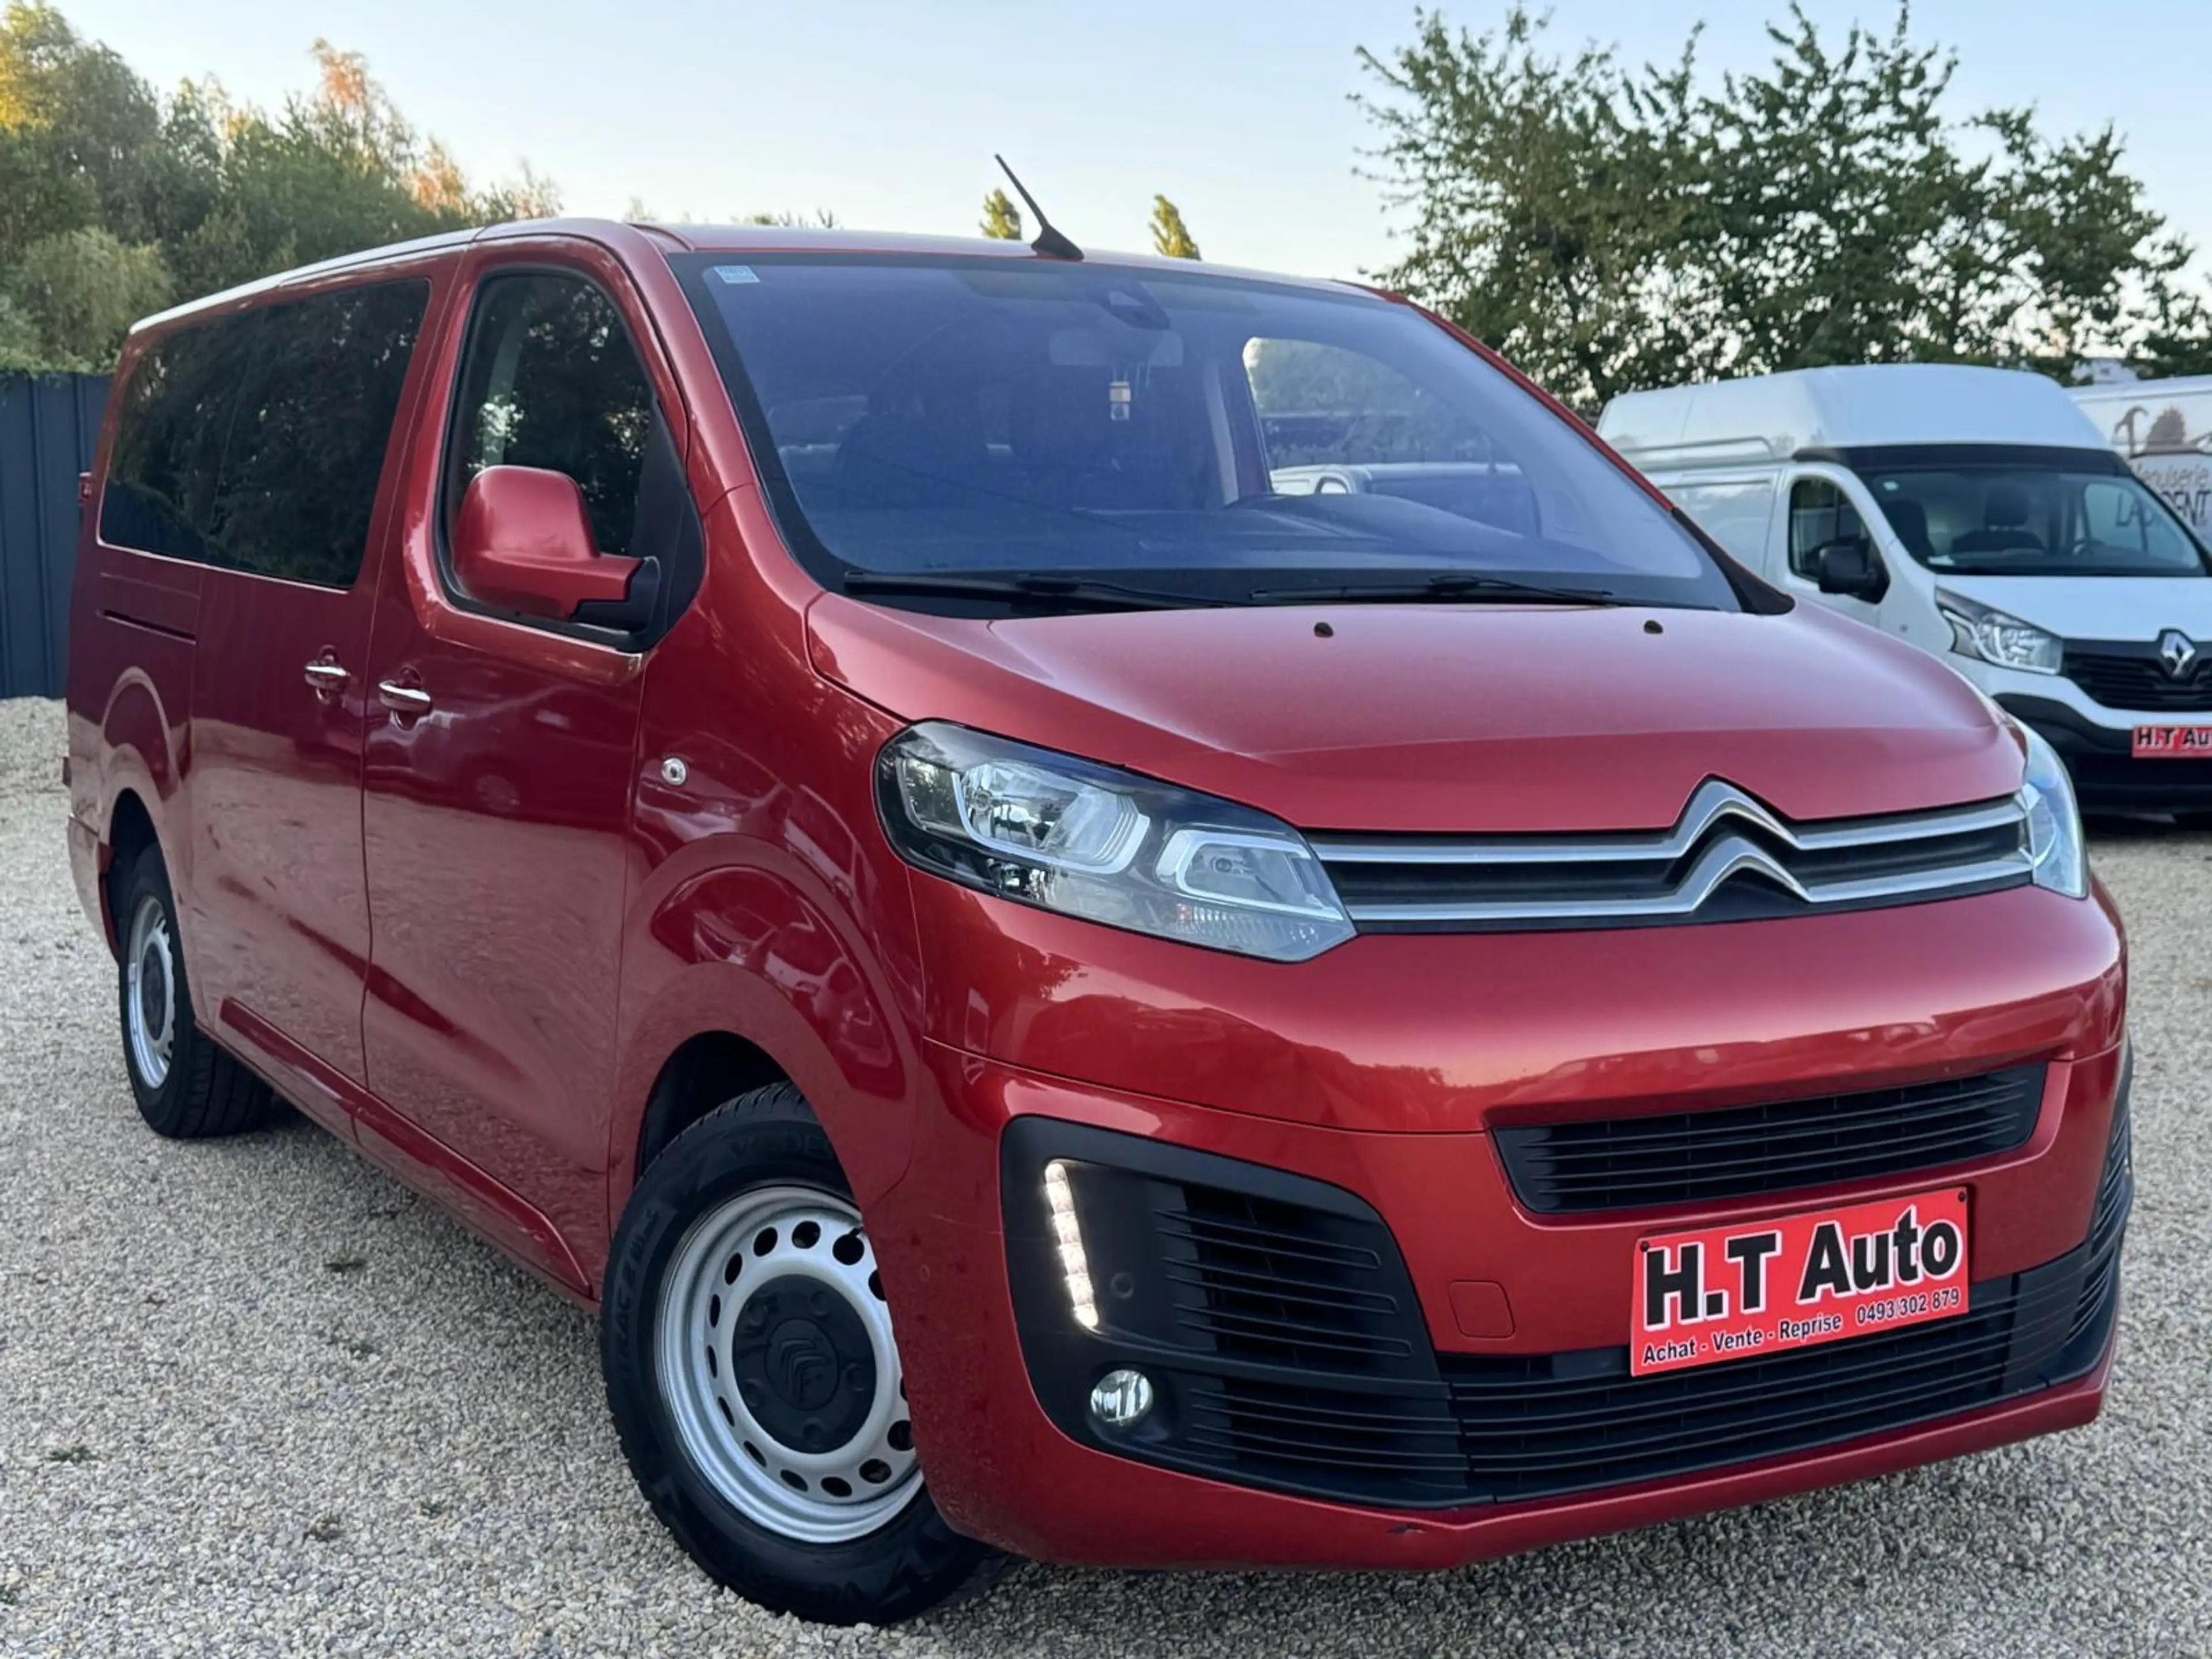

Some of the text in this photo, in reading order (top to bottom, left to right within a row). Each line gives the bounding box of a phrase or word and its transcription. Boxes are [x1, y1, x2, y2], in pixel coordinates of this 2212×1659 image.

[2138, 726, 2212, 745] H.T Au
[1645, 1206, 1960, 1328] H.T Auto
[1643, 1339, 1696, 1365] Achat
[1712, 1329, 1763, 1351] Vente
[1779, 1313, 1842, 1342] Reprise
[1932, 1287, 1959, 1309] 879
